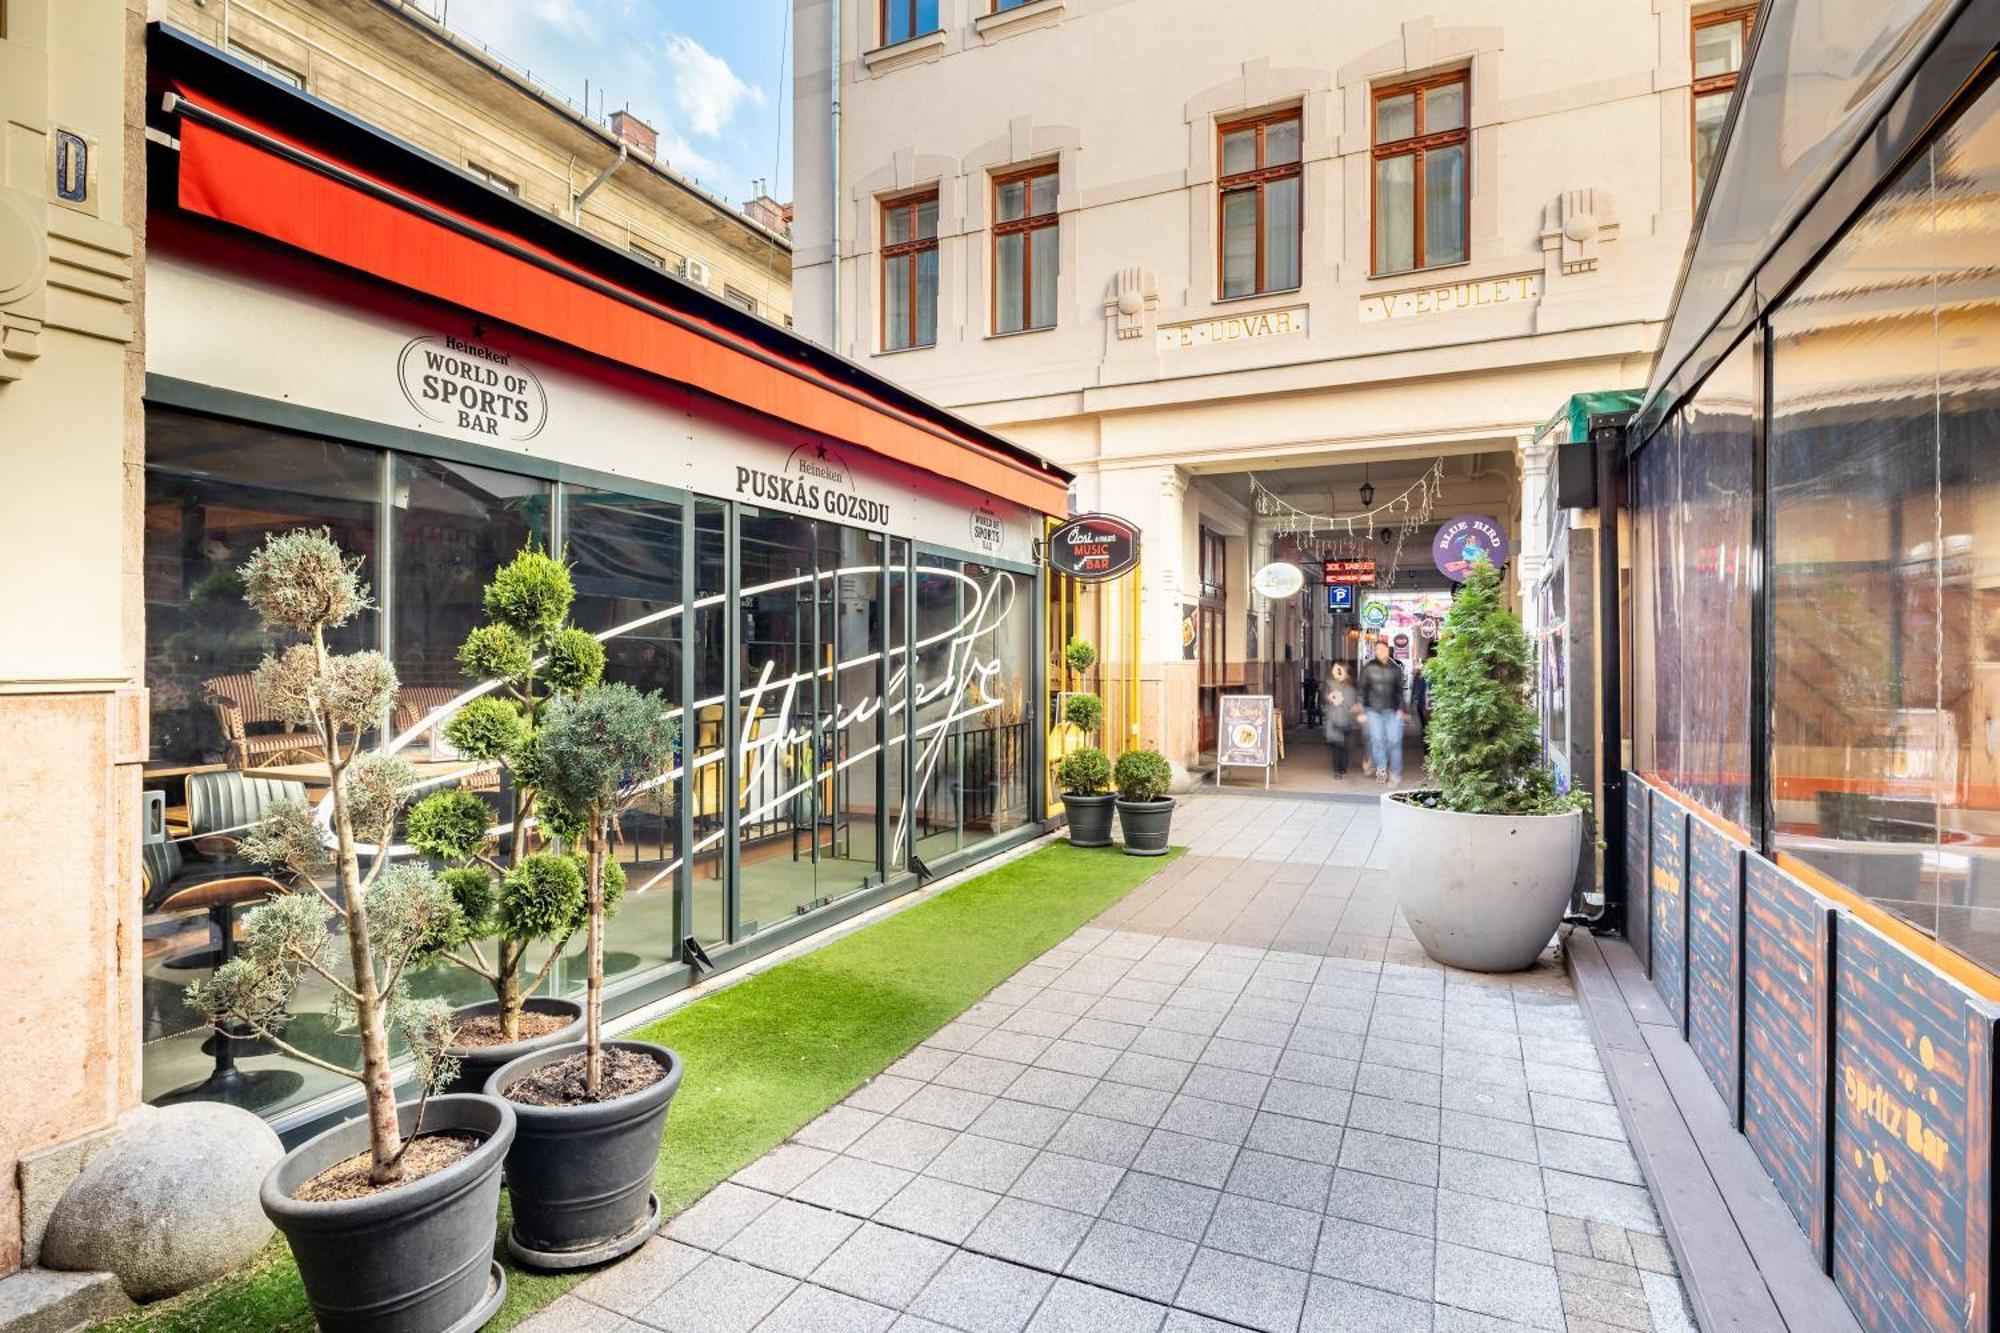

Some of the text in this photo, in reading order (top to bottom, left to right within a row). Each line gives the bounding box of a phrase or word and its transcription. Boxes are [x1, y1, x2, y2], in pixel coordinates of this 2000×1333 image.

[446, 335, 509, 366] Heineken
[424, 350, 528, 396] WORLD OF
[422, 374, 529, 423] SPORTS
[457, 410, 499, 436] BAR
[799, 459, 843, 484] Heineken
[736, 466, 890, 526] PUSKÁS GOZSDU
[1074, 543, 1110, 556] MUSIC
[1440, 520, 1501, 550] BLUE BIRD
[1086, 558, 1110, 571] BAR
[1336, 591, 1346, 602] P
[1844, 1065, 1949, 1172] Spritz Bar
